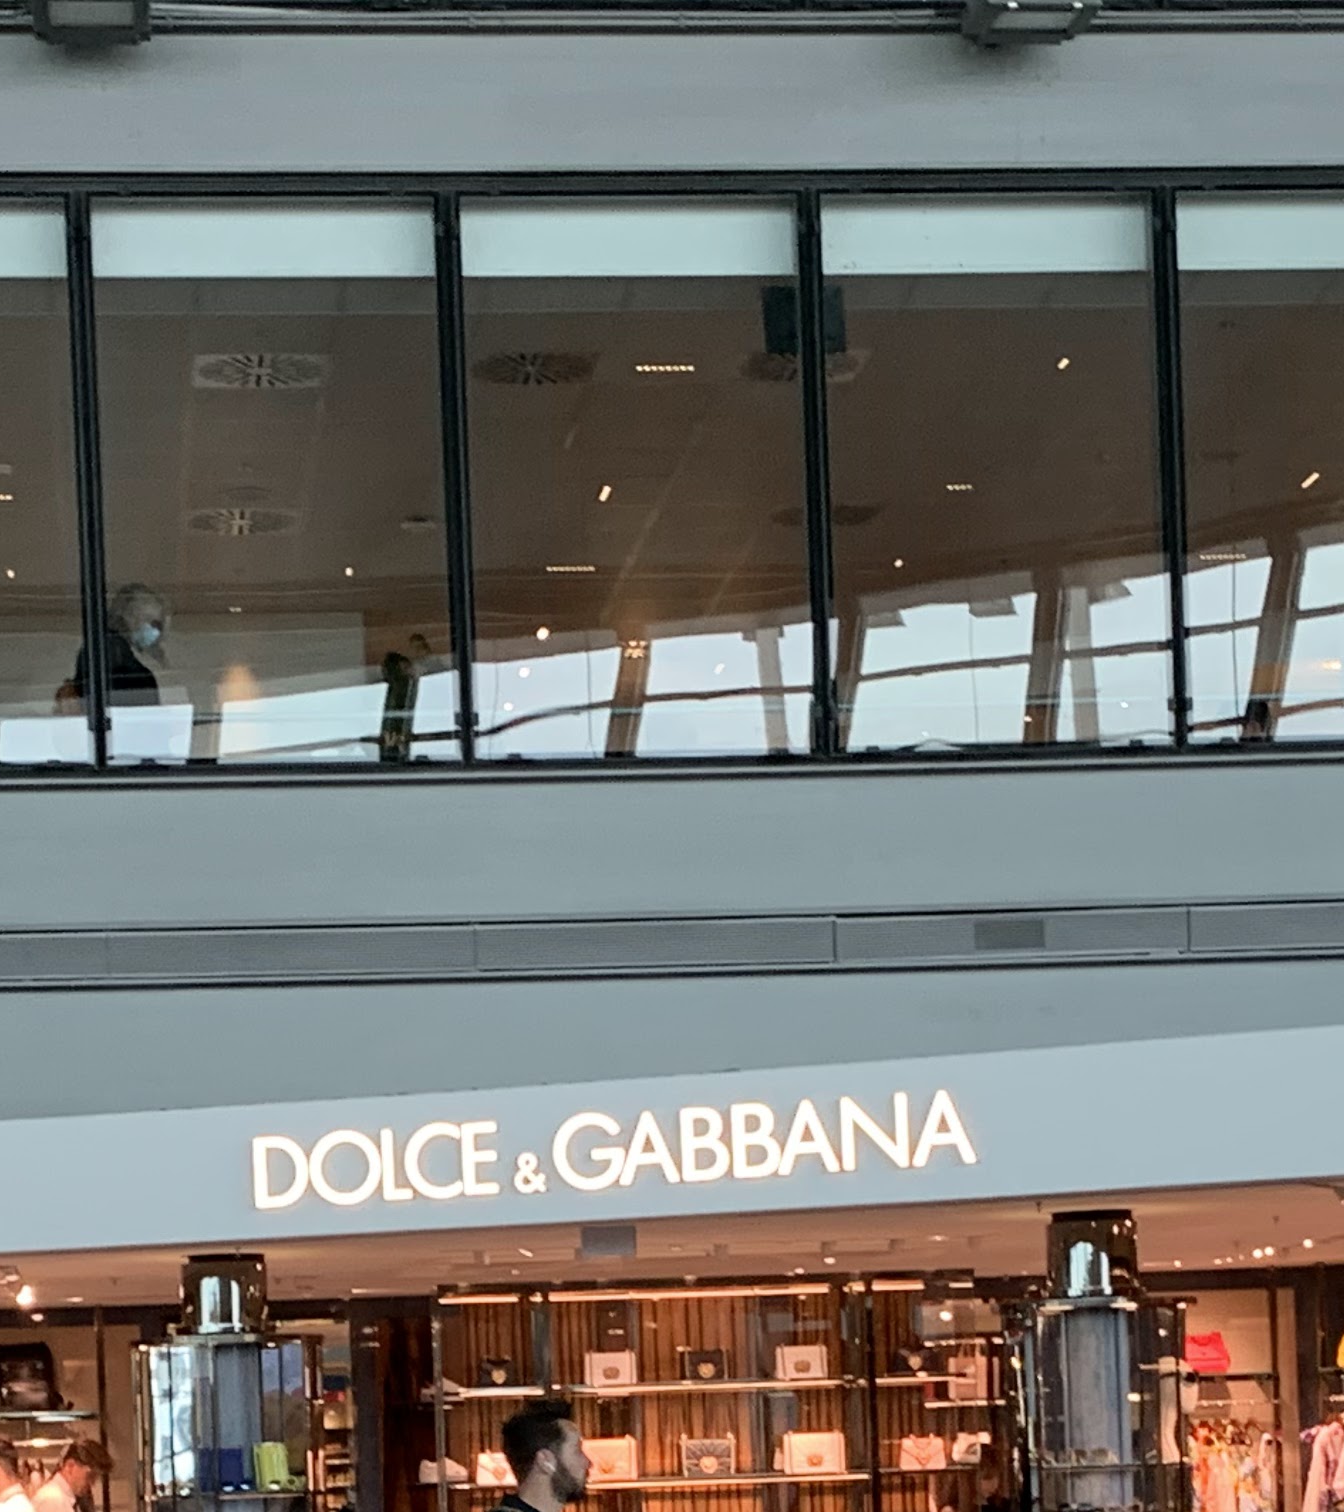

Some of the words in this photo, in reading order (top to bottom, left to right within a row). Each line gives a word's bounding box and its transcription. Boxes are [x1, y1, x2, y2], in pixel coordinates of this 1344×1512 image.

[251, 1119, 501, 1211] DOLCE
[513, 1151, 547, 1195] &
[552, 1088, 978, 1193] GABBANA
